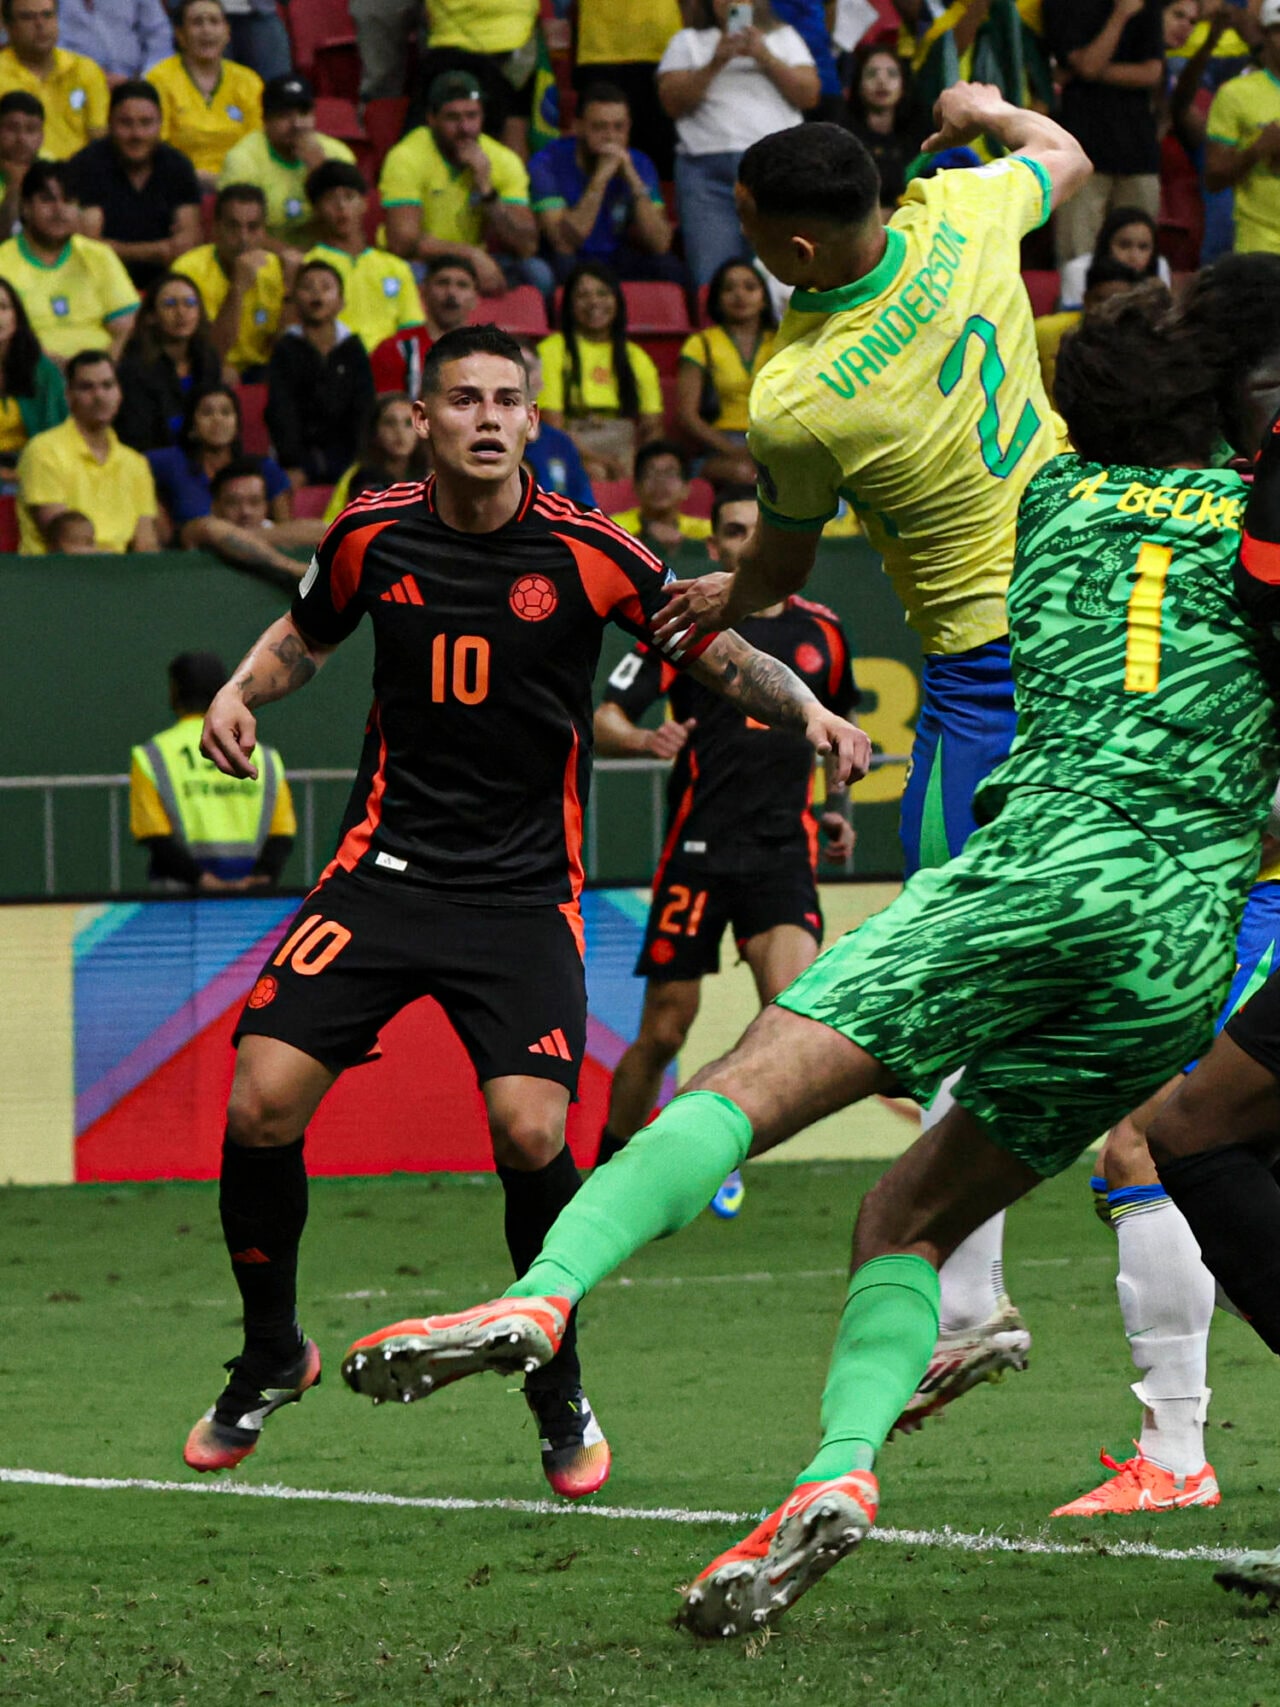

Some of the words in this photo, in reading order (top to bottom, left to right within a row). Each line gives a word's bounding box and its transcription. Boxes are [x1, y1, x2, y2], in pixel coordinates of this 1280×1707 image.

[817, 211, 968, 400] VANDERSON
[938, 314, 1041, 479] 2
[1068, 470, 1109, 504] A.
[1117, 481, 1247, 531] BECKE
[1124, 542, 1174, 693] 1
[432, 633, 490, 705] 10
[273, 915, 352, 976] 10
[657, 884, 708, 936] 21
